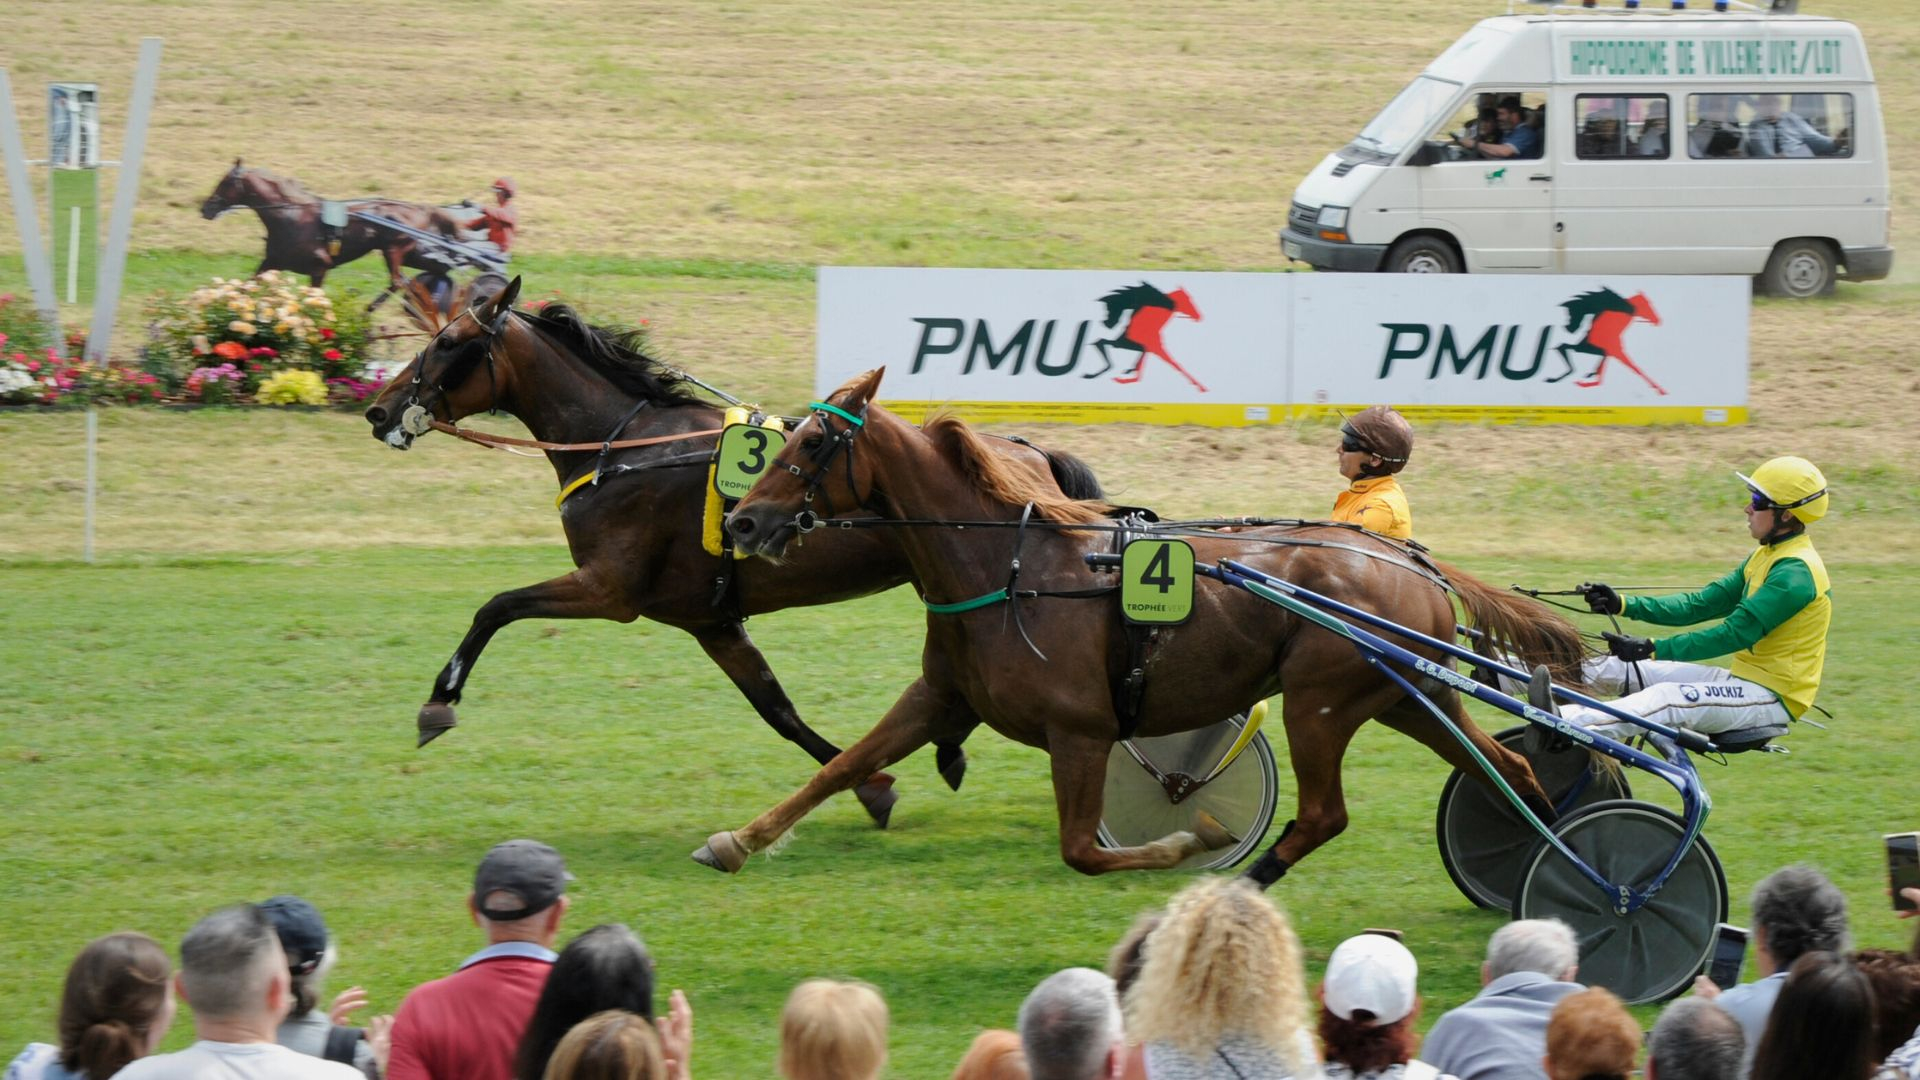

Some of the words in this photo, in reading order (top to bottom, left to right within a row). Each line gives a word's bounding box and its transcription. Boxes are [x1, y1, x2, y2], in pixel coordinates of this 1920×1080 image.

[1570, 40, 1669, 75] HIPPODROME
[1676, 40, 1696, 75] DE
[909, 317, 1091, 377] PMU
[1377, 323, 1554, 381] PMU
[737, 430, 768, 475] 3
[720, 480, 752, 491] TROPHÉ
[1140, 543, 1175, 594] 4
[1127, 602, 1167, 612] TROPHÉE
[1705, 685, 1745, 698] JOCKIZ
